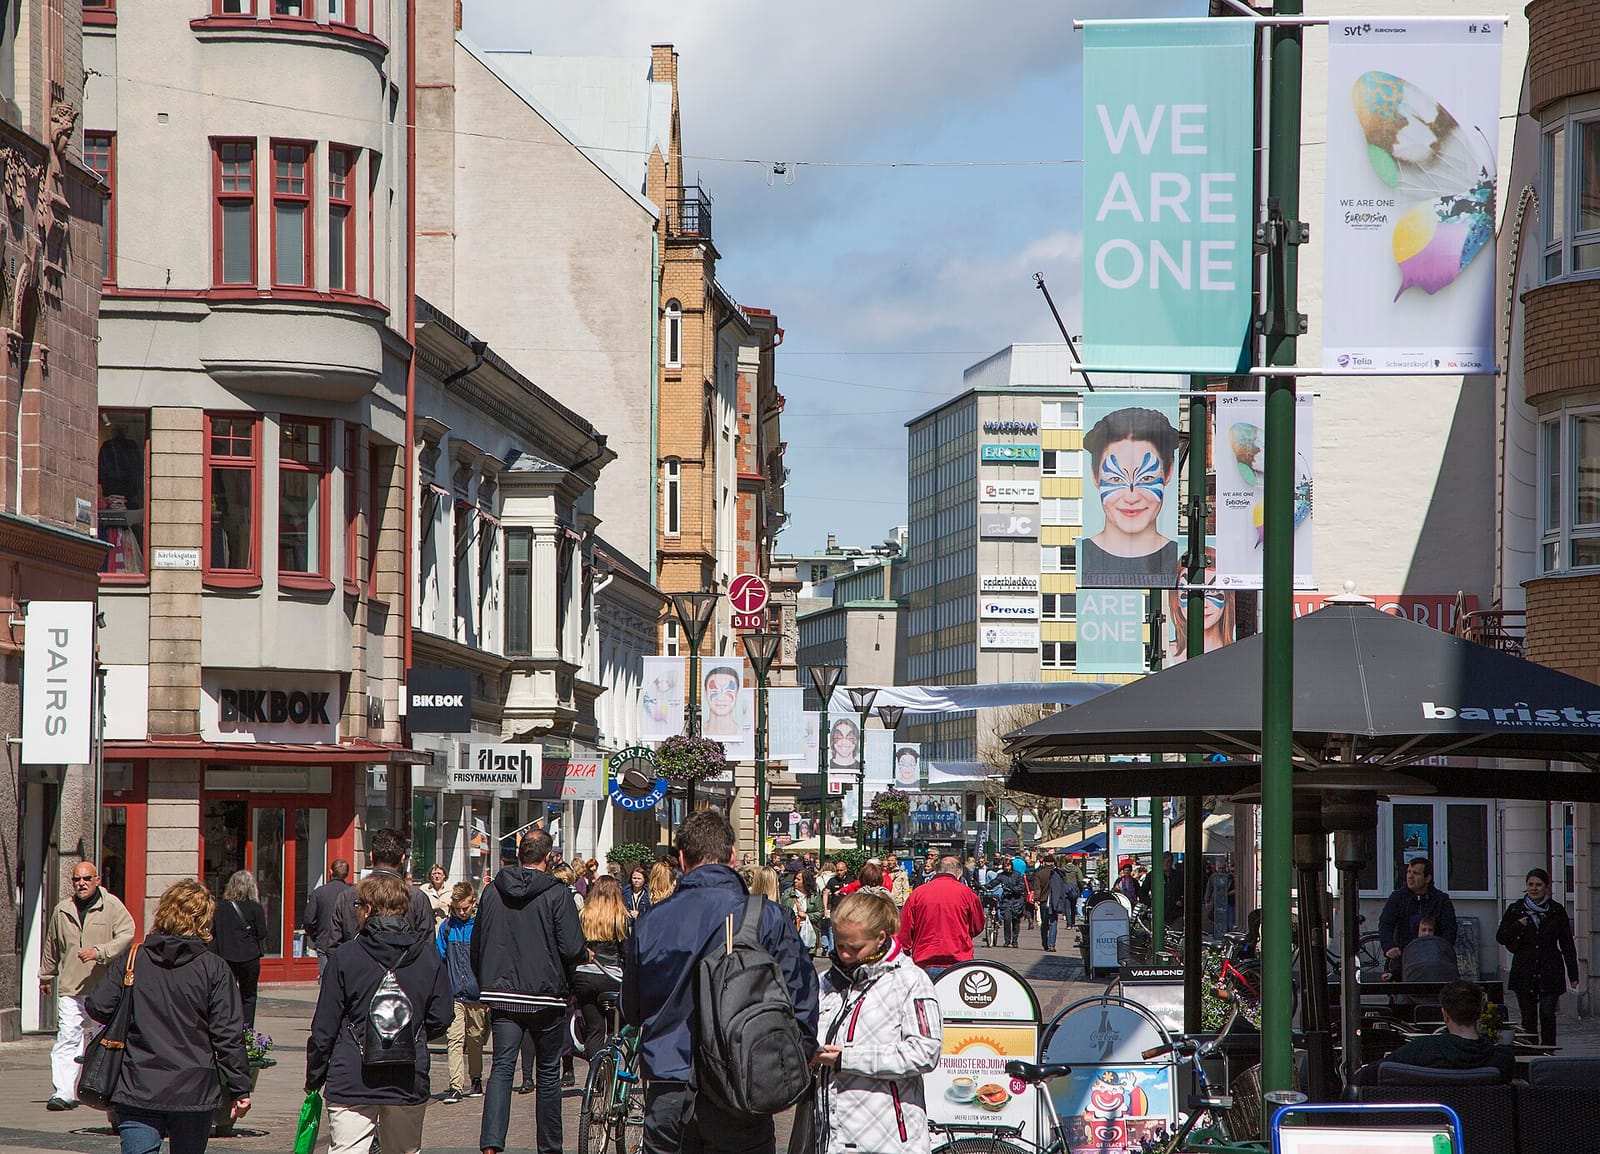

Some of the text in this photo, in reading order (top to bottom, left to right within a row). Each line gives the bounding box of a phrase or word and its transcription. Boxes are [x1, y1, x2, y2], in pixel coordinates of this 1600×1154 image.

[1344, 25, 1362, 36] svt
[1096, 104, 1208, 155] WE
[1096, 172, 1236, 223] ARE
[1376, 199, 1395, 207] ONE
[1095, 238, 1235, 291] ONE
[1352, 357, 1372, 366] Telia
[1386, 360, 1428, 368] Schwarzkopf
[985, 446, 1037, 459] EXPODENT
[1007, 516, 1032, 534] JC
[990, 605, 1035, 614] Prevas
[1081, 595, 1136, 615] ARE
[734, 616, 760, 627] BIO
[1080, 622, 1136, 642] ONE
[46, 628, 69, 737] PAIRS
[220, 688, 331, 725] BIK BOK
[412, 695, 463, 707] BIK BOK
[608, 749, 662, 777] ESPRES
[541, 763, 598, 777] ICTORIA
[453, 773, 518, 783] FRISYRMAKARNA
[611, 790, 663, 809] HOUSE
[1131, 969, 1184, 977] VAGABOND
[964, 993, 993, 1002] barista
